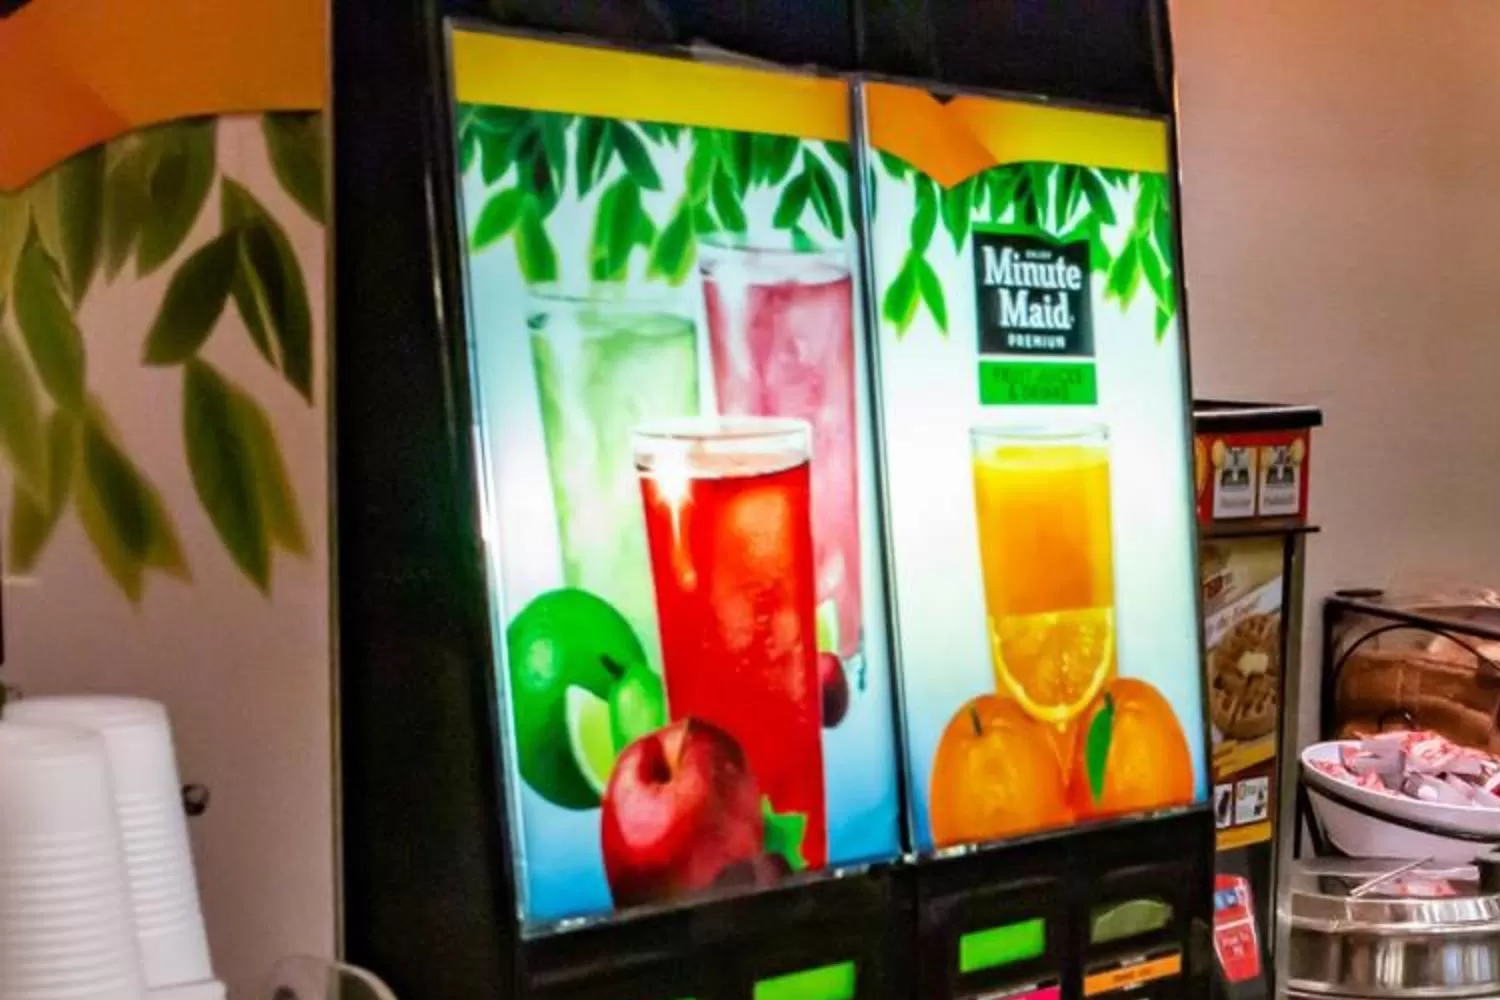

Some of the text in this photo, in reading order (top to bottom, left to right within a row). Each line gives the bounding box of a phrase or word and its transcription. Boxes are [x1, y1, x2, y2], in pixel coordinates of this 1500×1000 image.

[981, 245, 1082, 290] Minute
[997, 287, 1072, 330] Maid
[1007, 333, 1066, 349] PREMIUM
